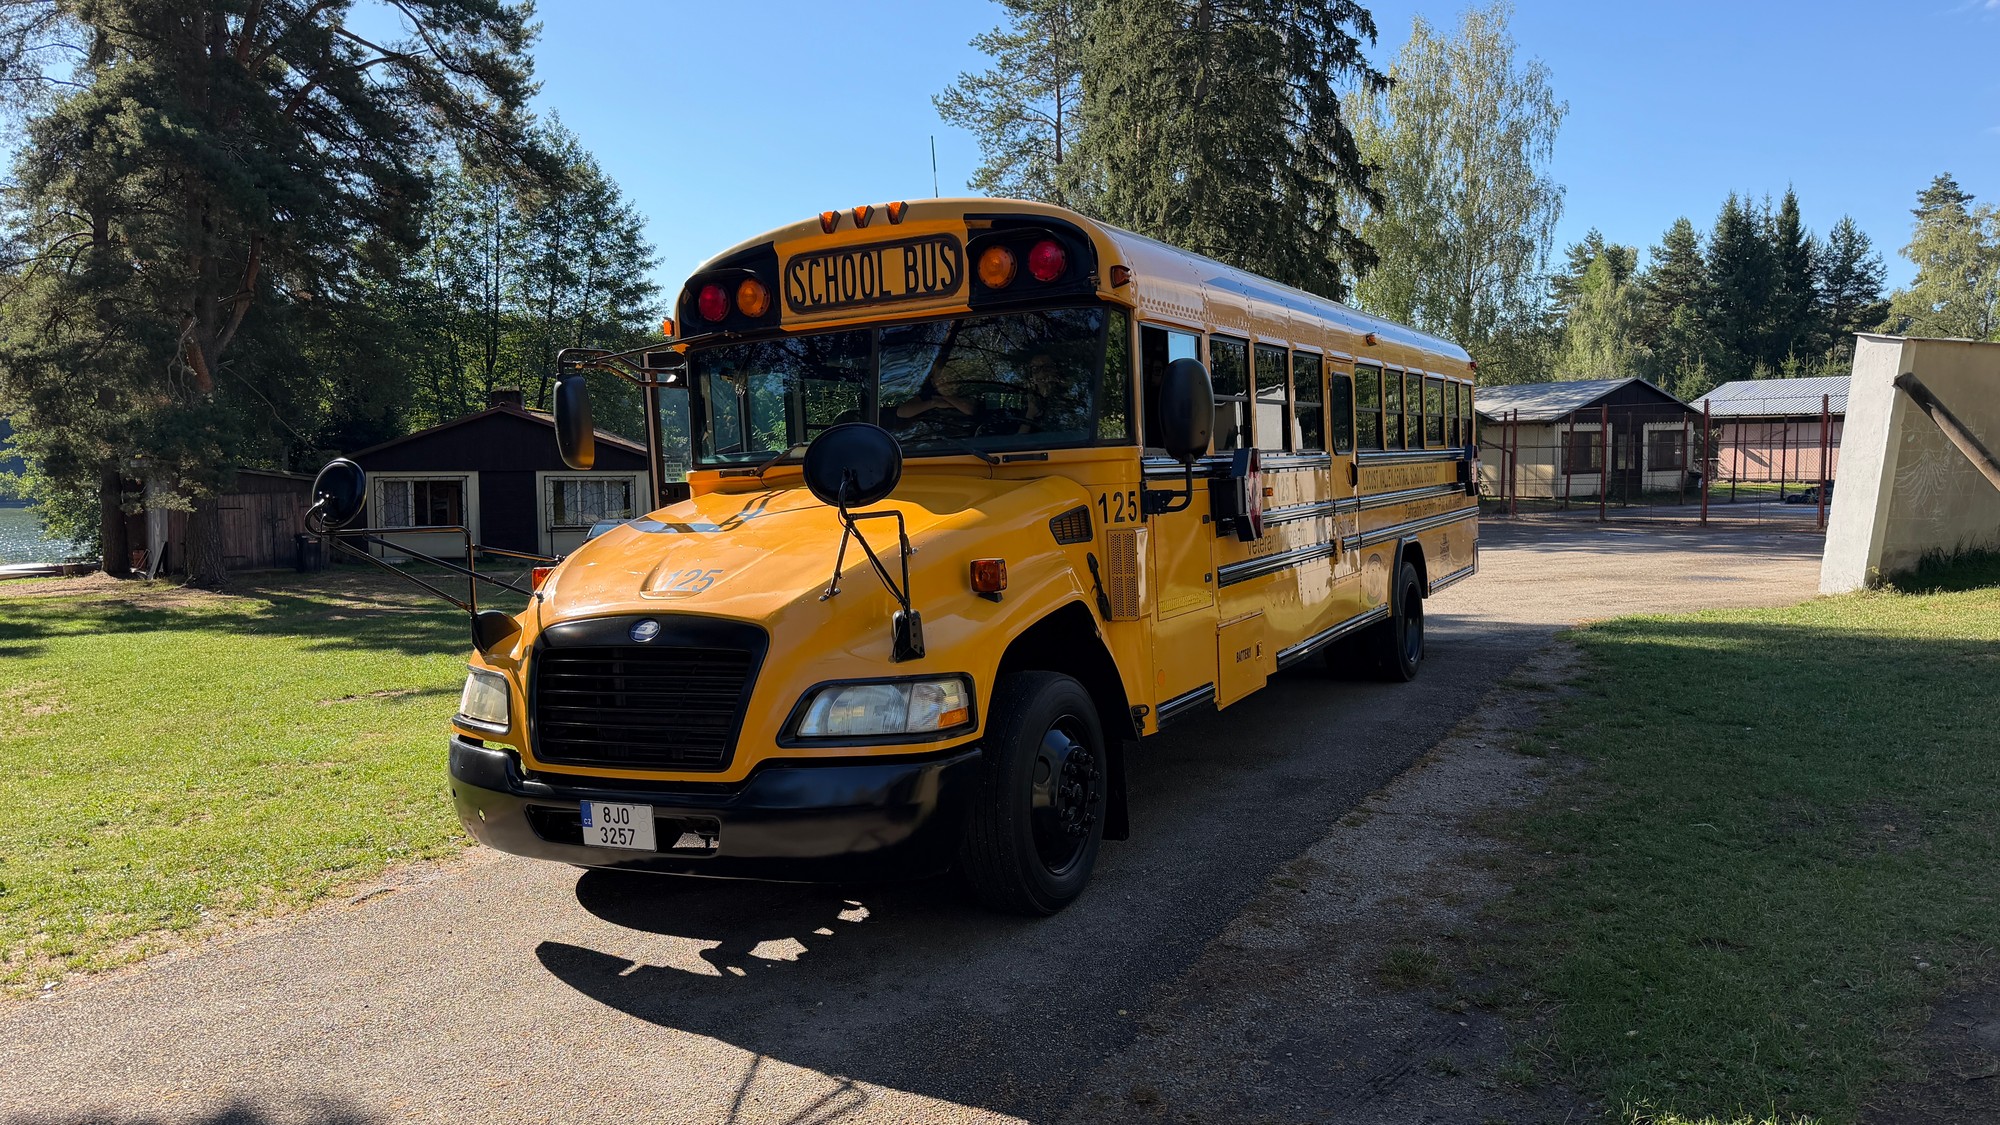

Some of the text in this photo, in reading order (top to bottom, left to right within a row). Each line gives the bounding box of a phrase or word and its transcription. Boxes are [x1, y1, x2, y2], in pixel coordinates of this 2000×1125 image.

[792, 241, 955, 306] SCHOOL BUS
[1276, 476, 1290, 502] 125
[1098, 491, 1137, 523] 125
[661, 568, 724, 593] 125
[603, 806, 630, 825] 8J0
[600, 826, 636, 846] 3257
